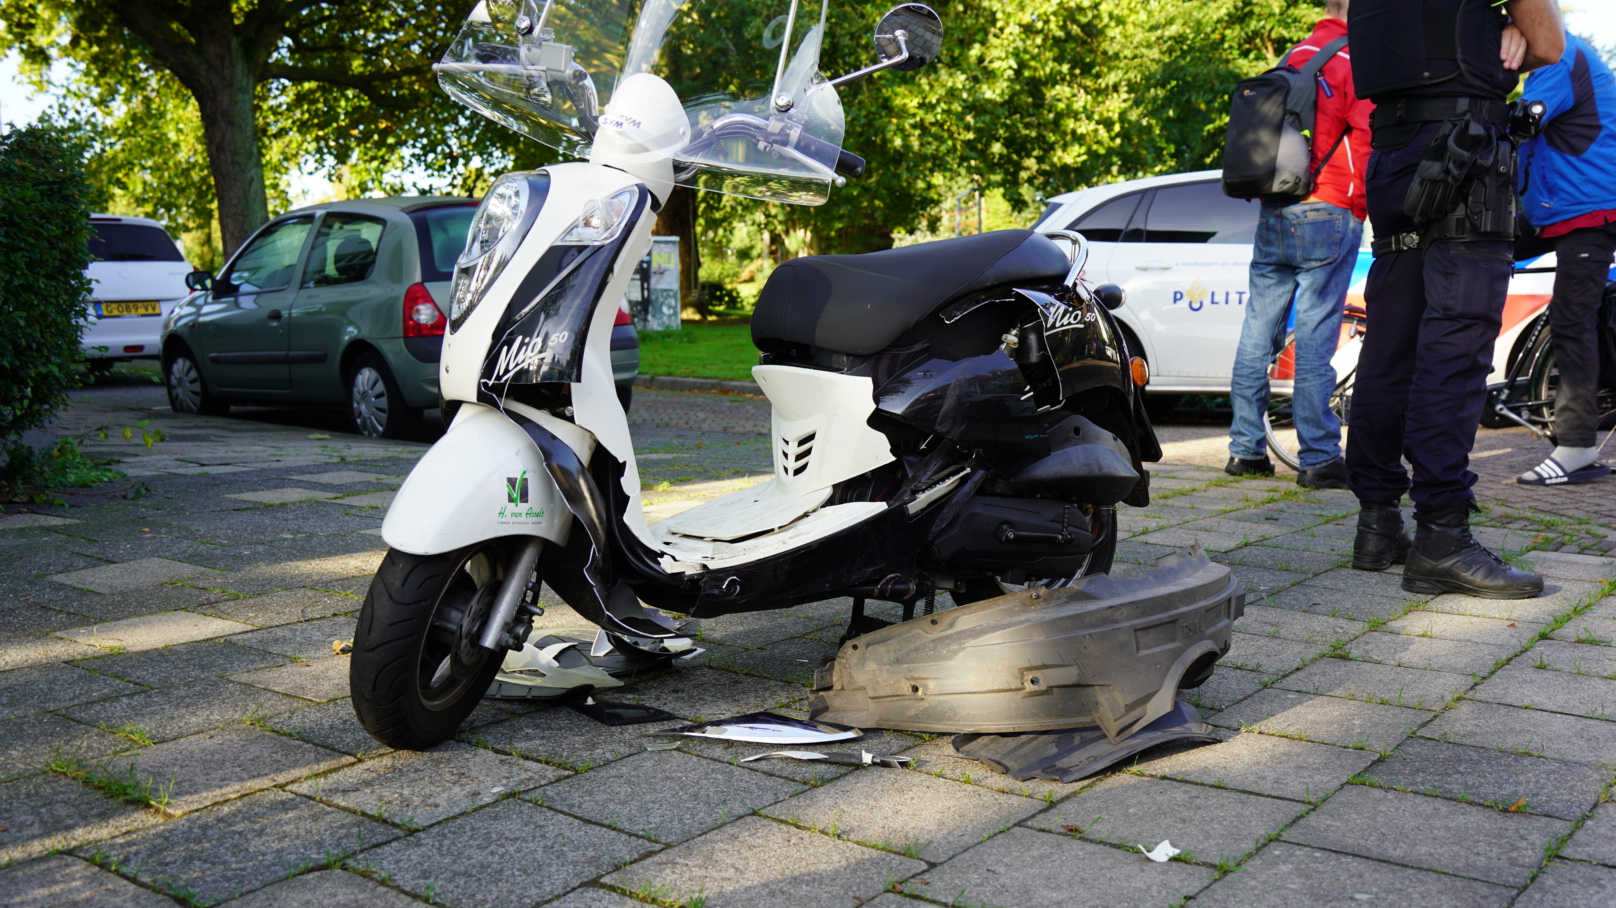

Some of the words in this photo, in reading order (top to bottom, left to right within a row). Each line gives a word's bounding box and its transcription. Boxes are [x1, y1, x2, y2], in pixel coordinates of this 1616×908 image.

[105, 303, 157, 314] G-089-VV
[1084, 312, 1096, 322] 50
[488, 335, 542, 387] Mio
[548, 331, 569, 346] 50
